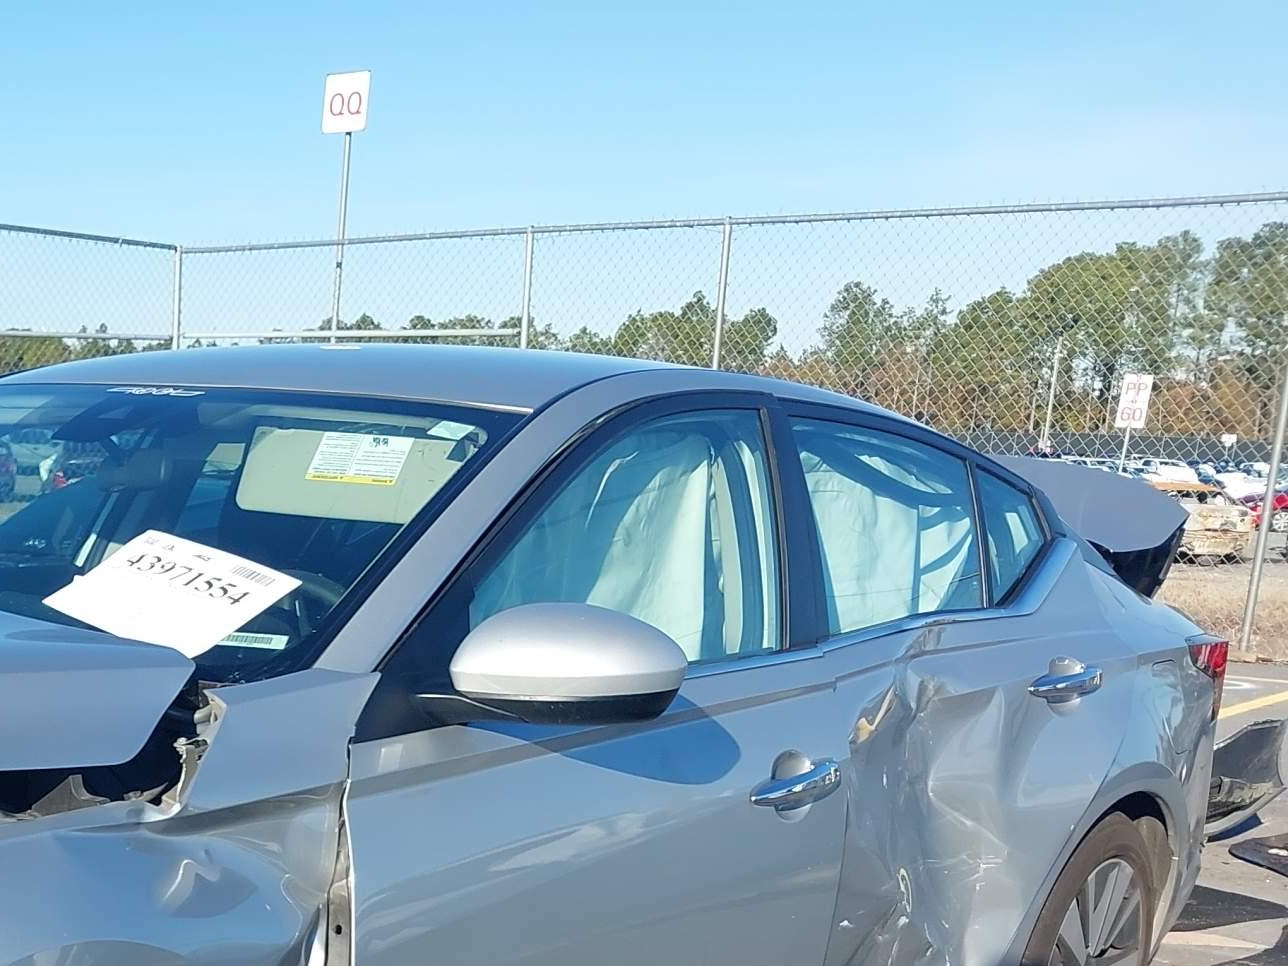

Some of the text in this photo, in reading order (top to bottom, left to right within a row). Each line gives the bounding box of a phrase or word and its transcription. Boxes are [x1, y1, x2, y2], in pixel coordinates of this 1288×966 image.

[329, 91, 362, 117] QQ
[1120, 406, 1143, 422] 60
[126, 553, 251, 606] 43971554
